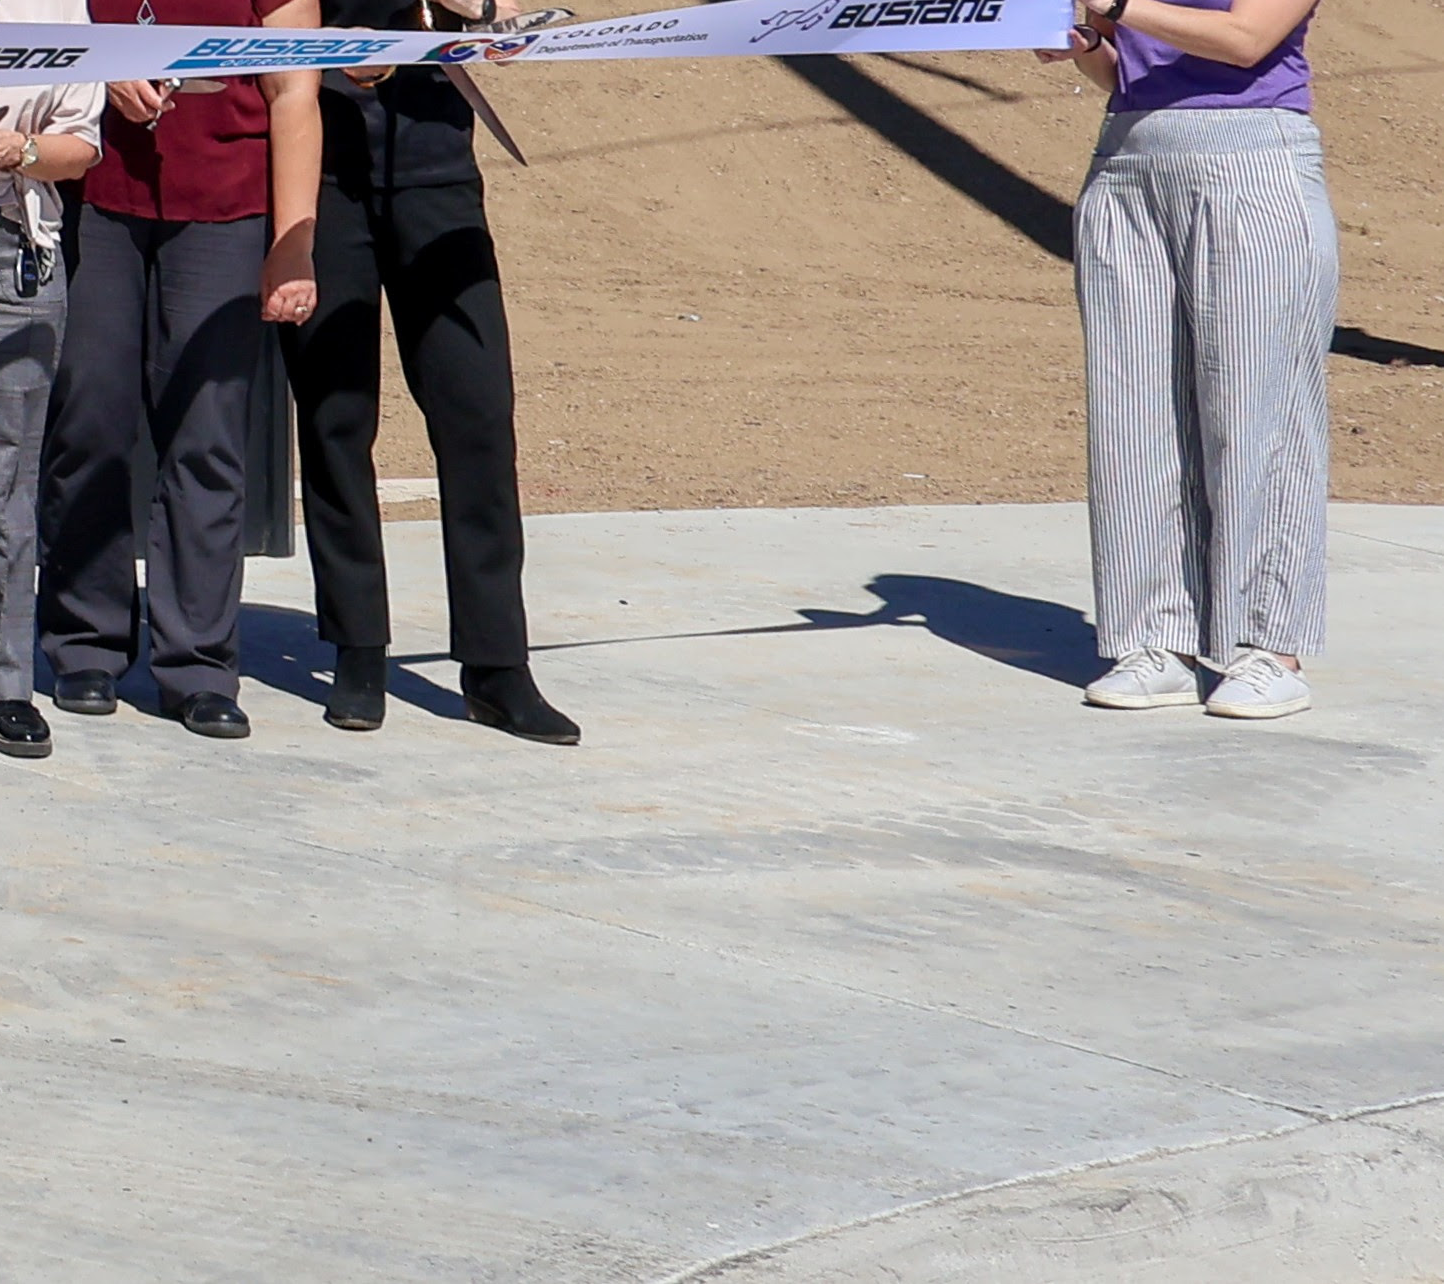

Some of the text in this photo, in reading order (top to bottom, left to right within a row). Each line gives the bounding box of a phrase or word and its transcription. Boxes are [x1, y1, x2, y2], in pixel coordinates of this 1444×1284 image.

[552, 19, 680, 40] COLORADO
[536, 41, 604, 54] Department
[622, 33, 709, 47] Transportation
[219, 57, 317, 67] OUTRIDER
